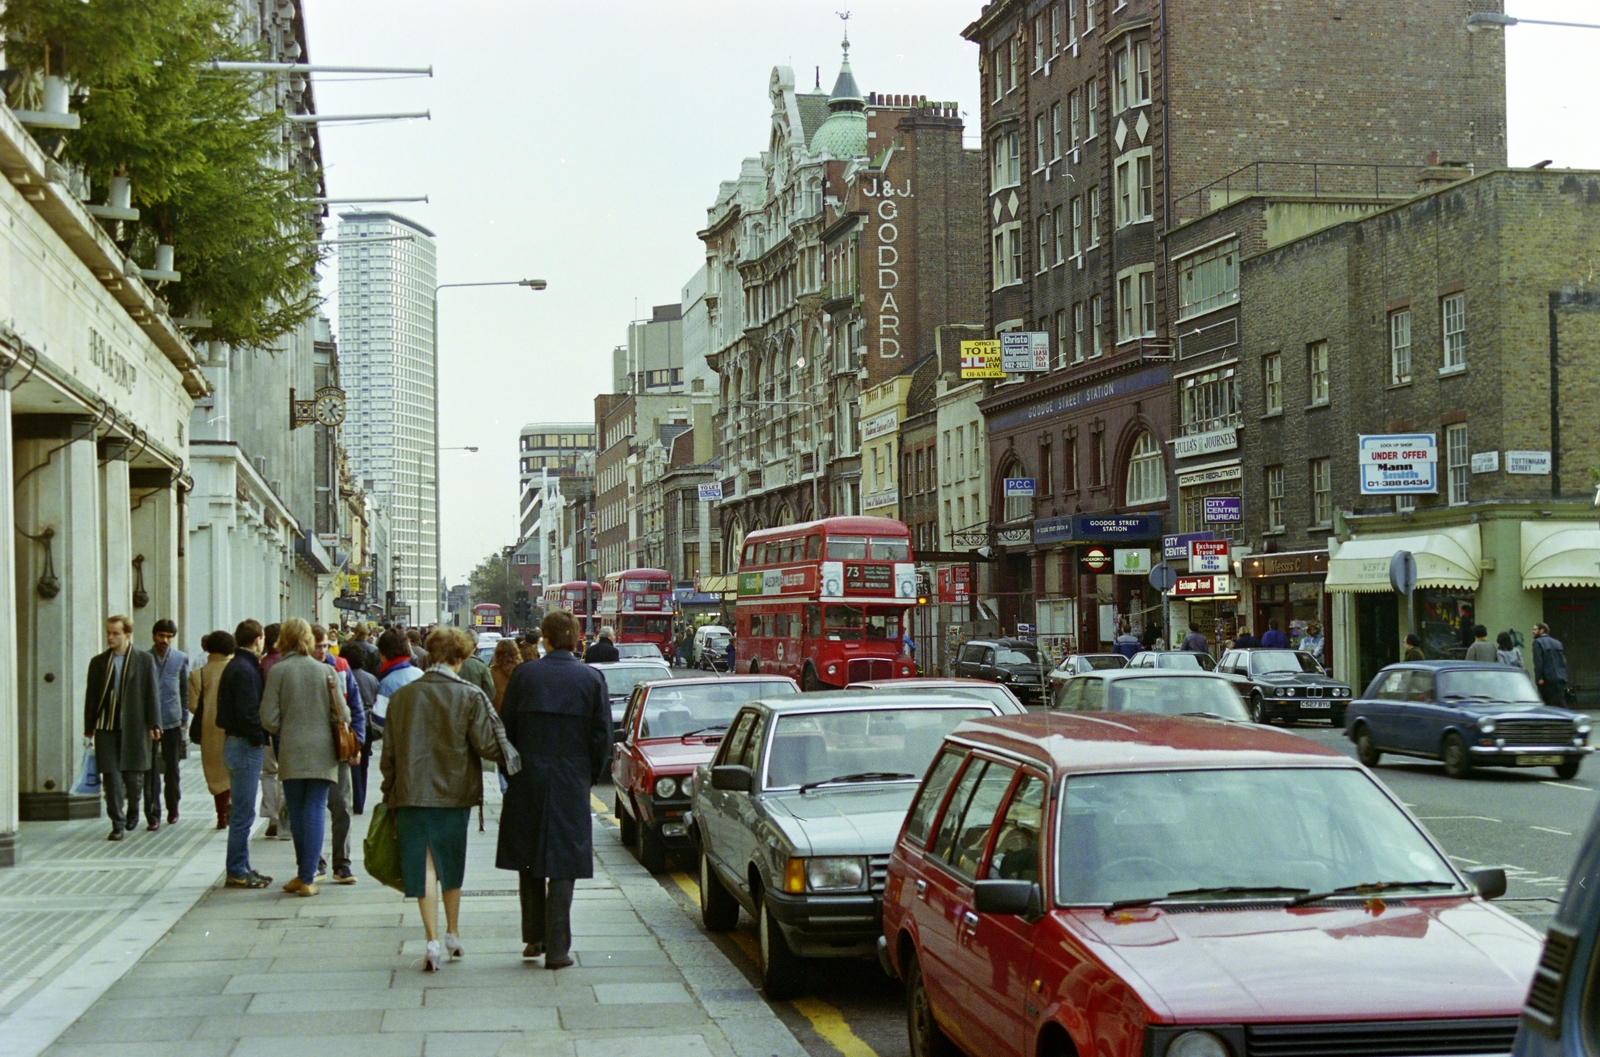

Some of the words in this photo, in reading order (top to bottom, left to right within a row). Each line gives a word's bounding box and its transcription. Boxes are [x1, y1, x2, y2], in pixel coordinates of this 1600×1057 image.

[1004, 335, 1028, 345] Christo
[964, 347, 981, 355] TO
[1028, 401, 1053, 418] GOODGE
[1058, 392, 1080, 409] STREET
[1086, 382, 1114, 401] STATION
[1175, 439, 1198, 454] JULIA'S
[1204, 432, 1236, 449] JOURNEYS
[1371, 451, 1398, 460] UNDER
[1402, 450, 1427, 459] OFFER
[1511, 457, 1546, 465] TOTTENHAM
[1181, 474, 1204, 484] COMPUTER
[1205, 468, 1239, 479] RECRUITMENT
[1382, 471, 1419, 479] Smith
[1009, 480, 1032, 489] P.C.C.
[1206, 513, 1240, 521] BUREAU
[1164, 537, 1178, 547] CITY
[1196, 542, 1224, 550] Exchange
[1164, 546, 1188, 556] CENTRE
[846, 566, 860, 577] 73
[1436, 602, 1460, 629] SALE
